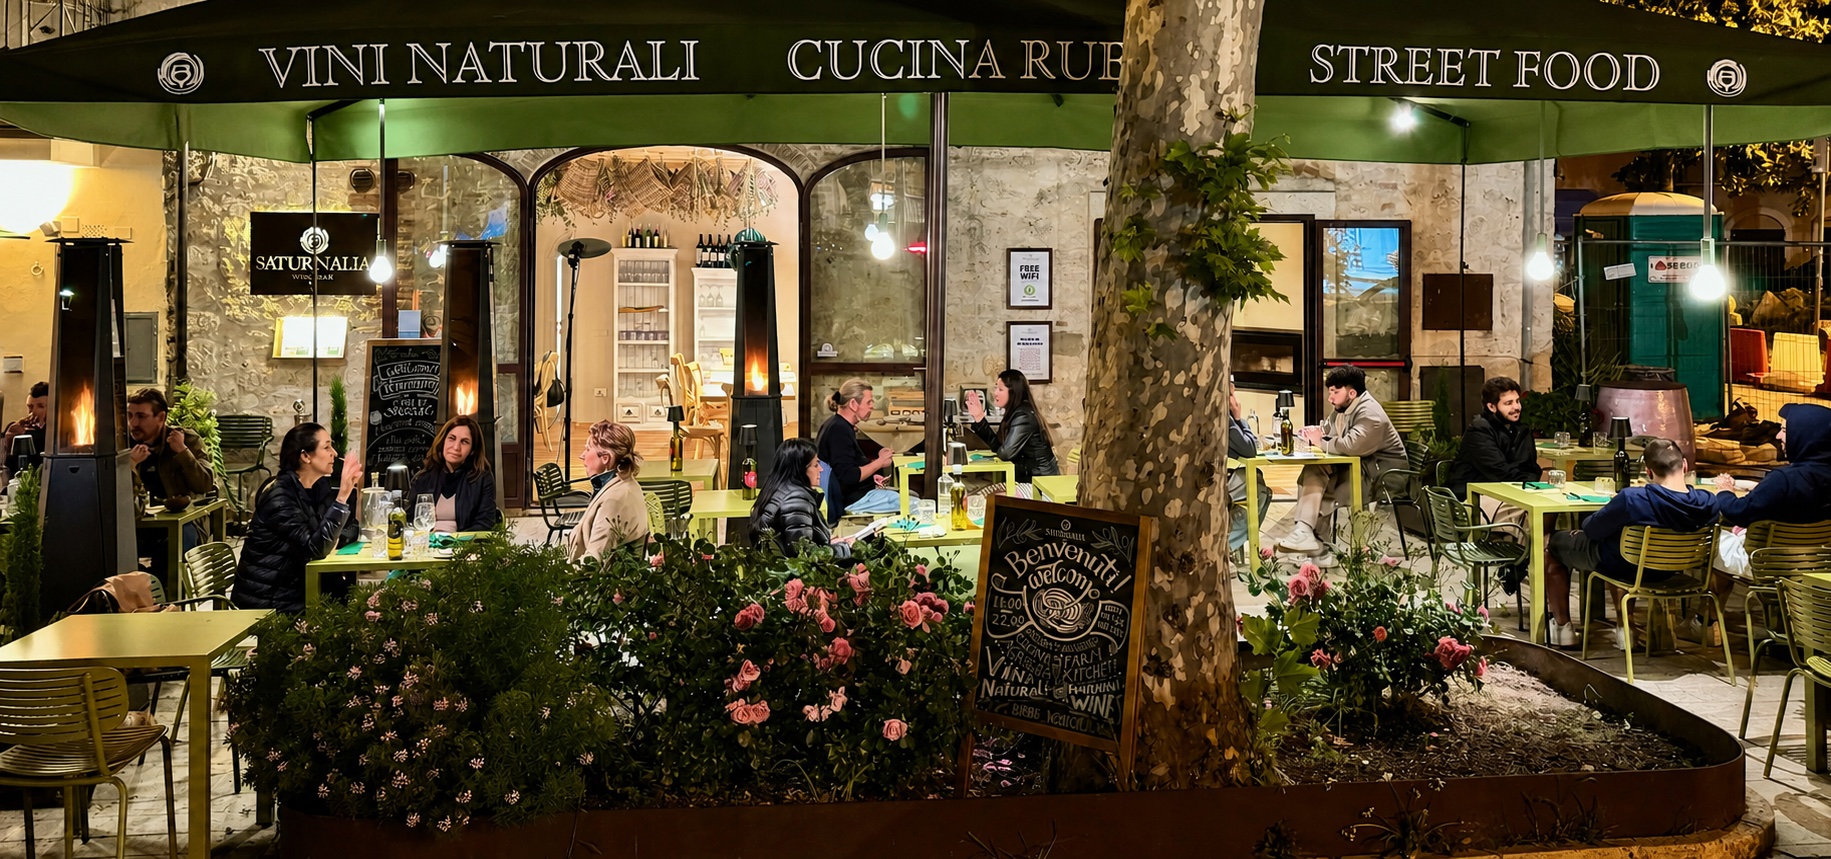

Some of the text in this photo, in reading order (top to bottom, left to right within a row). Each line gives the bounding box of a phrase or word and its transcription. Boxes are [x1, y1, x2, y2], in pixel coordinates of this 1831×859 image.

[258, 40, 701, 89] VINI NATURALI
[787, 38, 1007, 81] CUCINA
[1309, 43, 1661, 92] STREET FOOD
[255, 255, 370, 272] SATURNALIA
[1004, 541, 1132, 594] Benvenuti!
